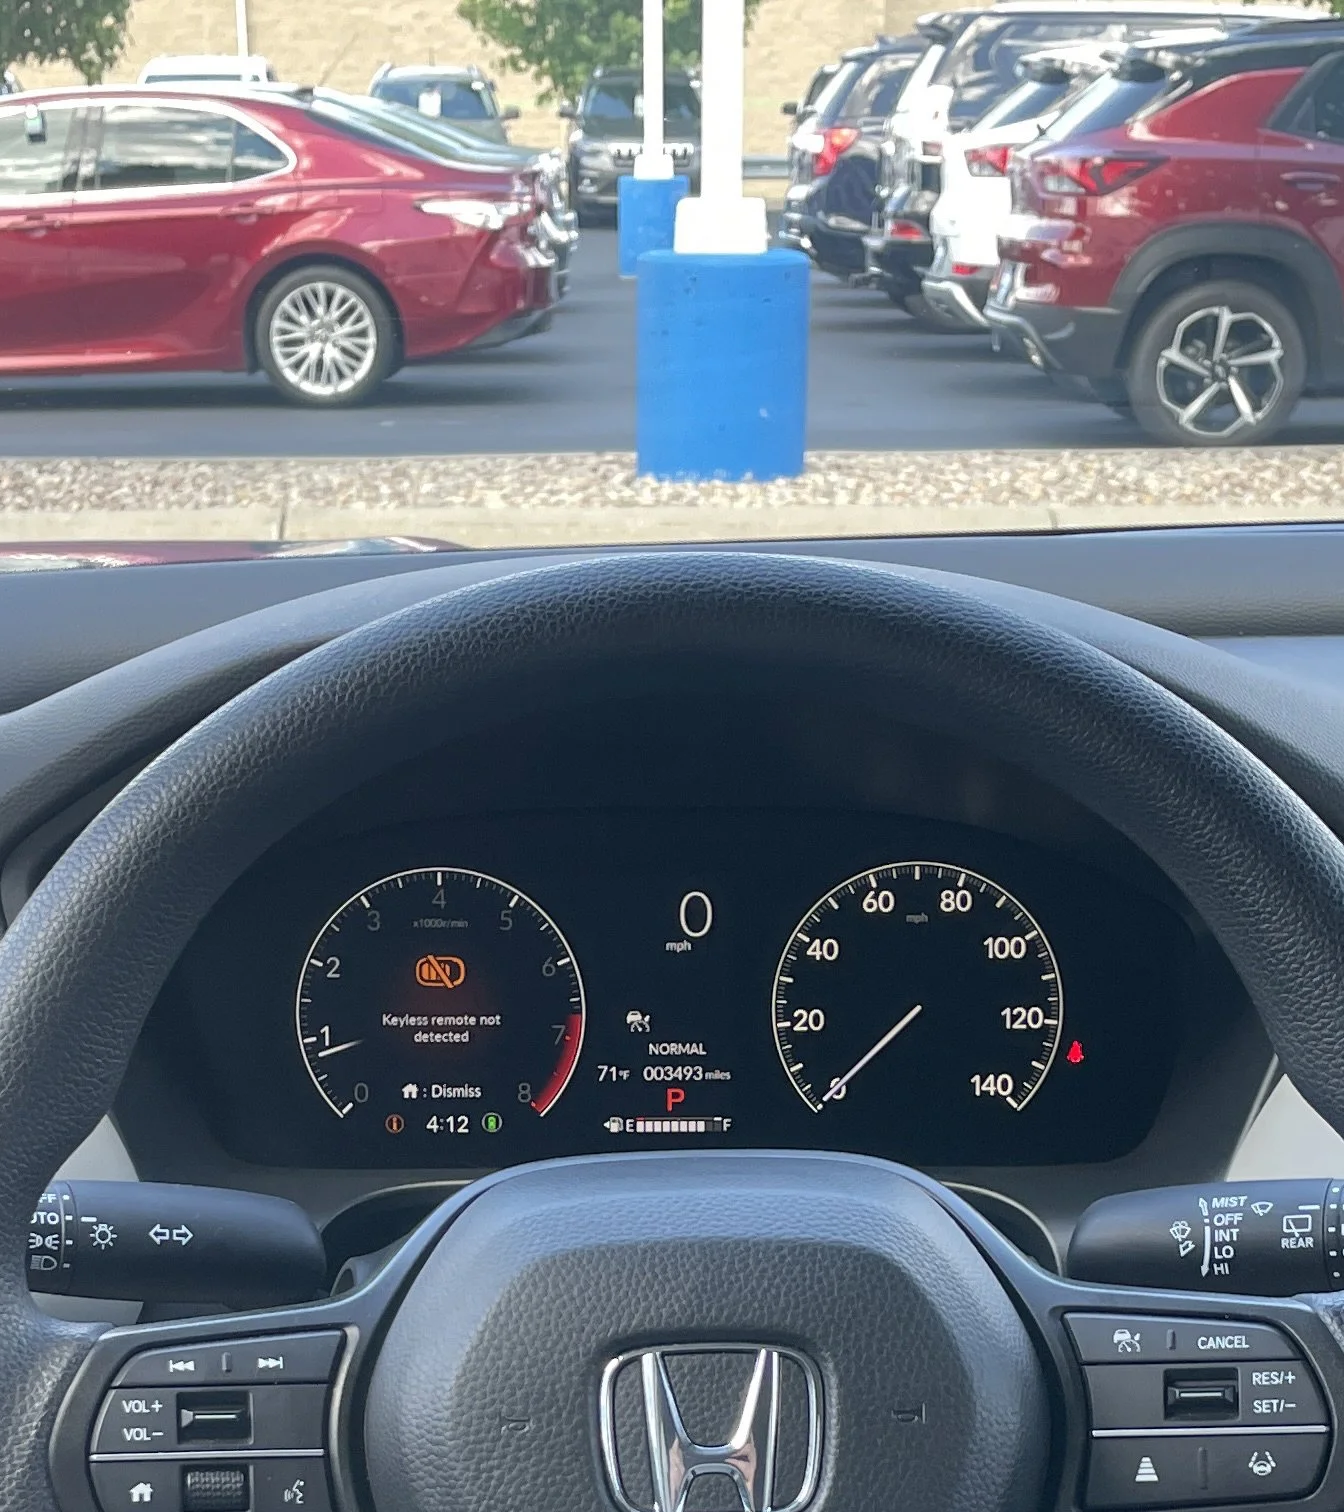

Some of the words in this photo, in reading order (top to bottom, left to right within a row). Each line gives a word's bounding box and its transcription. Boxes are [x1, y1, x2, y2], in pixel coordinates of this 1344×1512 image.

[431, 888, 447, 909] 4
[862, 889, 895, 913] 60
[940, 889, 973, 913] 80
[367, 911, 381, 931] 3
[499, 910, 513, 931] 5
[679, 891, 713, 938] 0
[906, 912, 929, 924] mph
[665, 940, 692, 953] mph
[806, 938, 839, 961] 40
[983, 936, 1027, 960] 100
[326, 957, 341, 979] 2
[542, 957, 556, 977] 6
[382, 1013, 429, 1027] Keyless
[431, 1014, 476, 1026] remote
[480, 1014, 501, 1026] not
[792, 1009, 825, 1032] 20
[1001, 1006, 1045, 1030] 120
[319, 1025, 331, 1047] 1
[414, 1030, 470, 1043] detected
[551, 1025, 566, 1046] 7
[648, 1043, 707, 1056] NORMAL
[643, 1065, 703, 1082] 003493
[705, 1069, 732, 1081] miles
[353, 1082, 369, 1103] 0
[431, 1083, 482, 1099] Dismiss
[517, 1082, 532, 1103] 8
[970, 1073, 1014, 1097] 140
[666, 1087, 686, 1112] P
[426, 1115, 470, 1134] 4:12
[626, 1119, 635, 1133] E
[723, 1119, 732, 1132] F
[1212, 1196, 1248, 1209] MIST
[1213, 1213, 1243, 1226] OFF
[1214, 1229, 1240, 1242] INT
[1281, 1237, 1314, 1249] REAR
[1214, 1246, 1234, 1259] LO
[1213, 1263, 1230, 1276] HI
[1198, 1336, 1250, 1350] CANCEL
